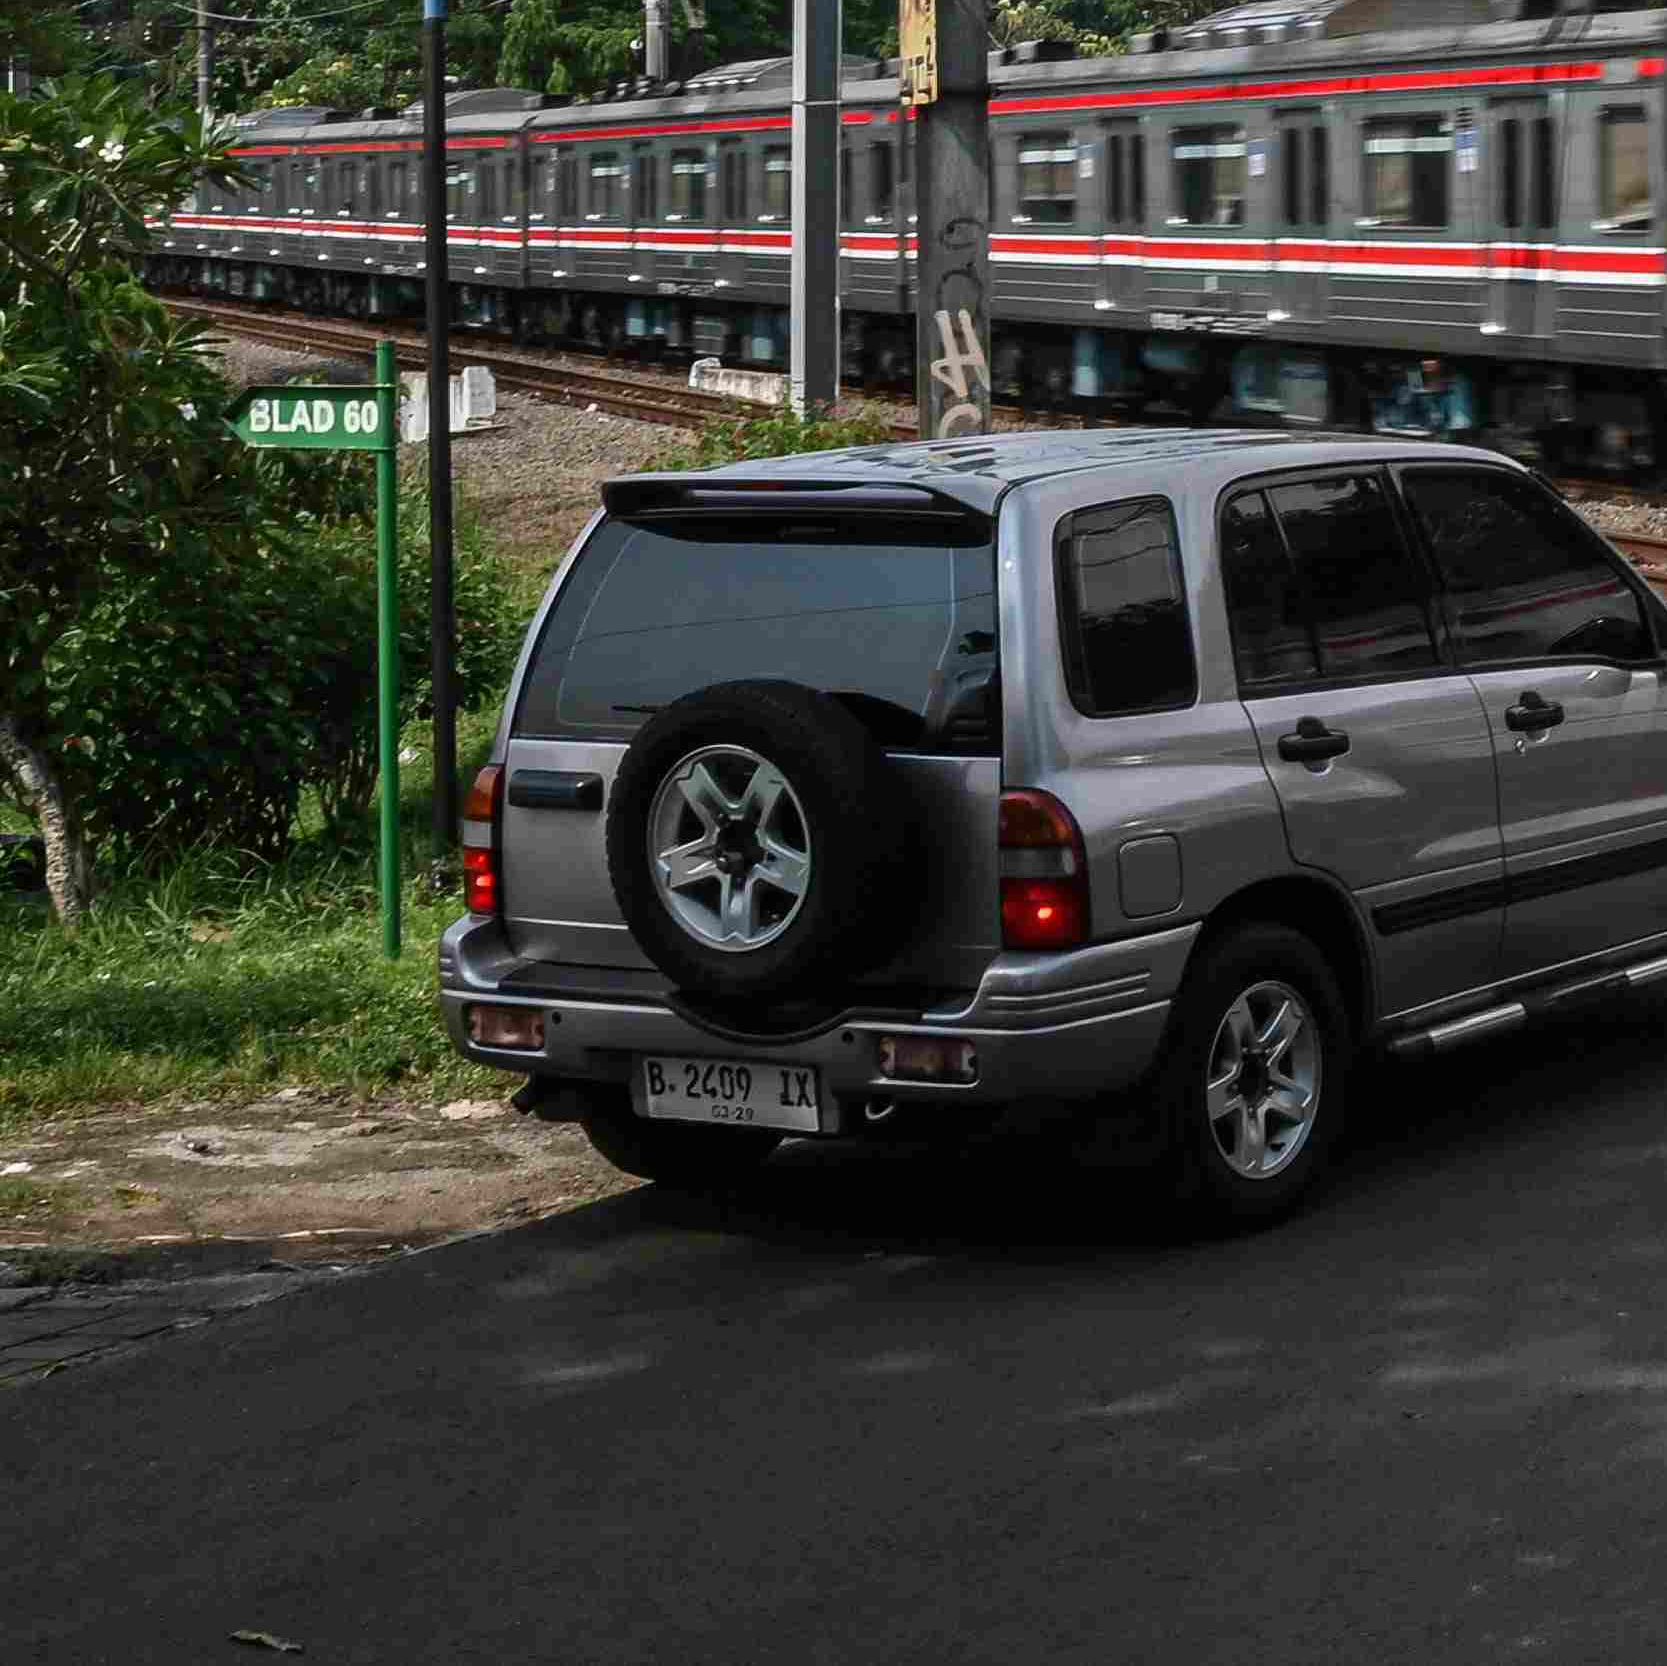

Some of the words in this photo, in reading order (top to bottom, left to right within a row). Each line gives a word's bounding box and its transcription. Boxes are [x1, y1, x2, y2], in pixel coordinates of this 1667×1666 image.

[250, 398, 335, 433] BLAD
[343, 399, 379, 434] 60
[684, 1063, 753, 1102] 2409
[779, 1069, 814, 1109] IX
